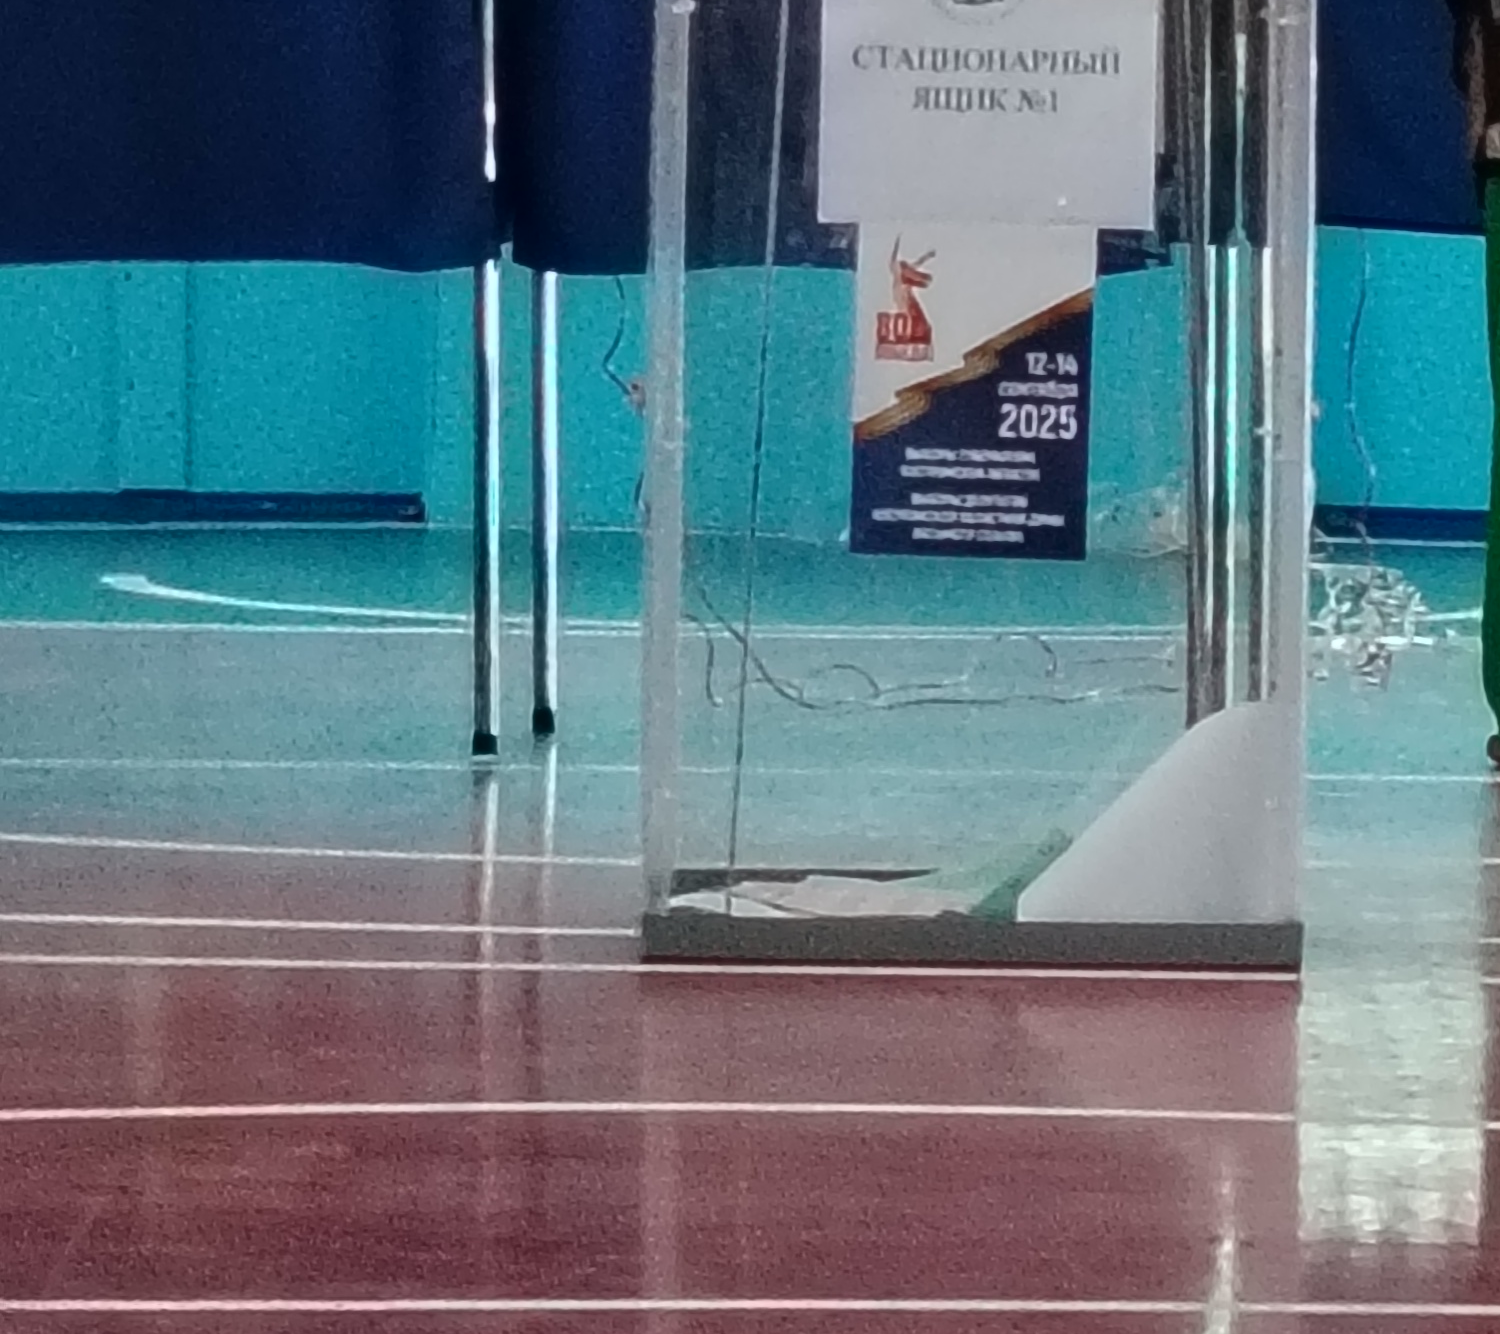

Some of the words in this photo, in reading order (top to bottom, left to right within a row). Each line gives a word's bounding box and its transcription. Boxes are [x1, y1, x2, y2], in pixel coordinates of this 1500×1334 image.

[852, 44, 1119, 74] СТАЦИОНАРНЫЙ
[912, 86, 1007, 113] ЯЩИК
[998, 403, 1078, 440] 2025
